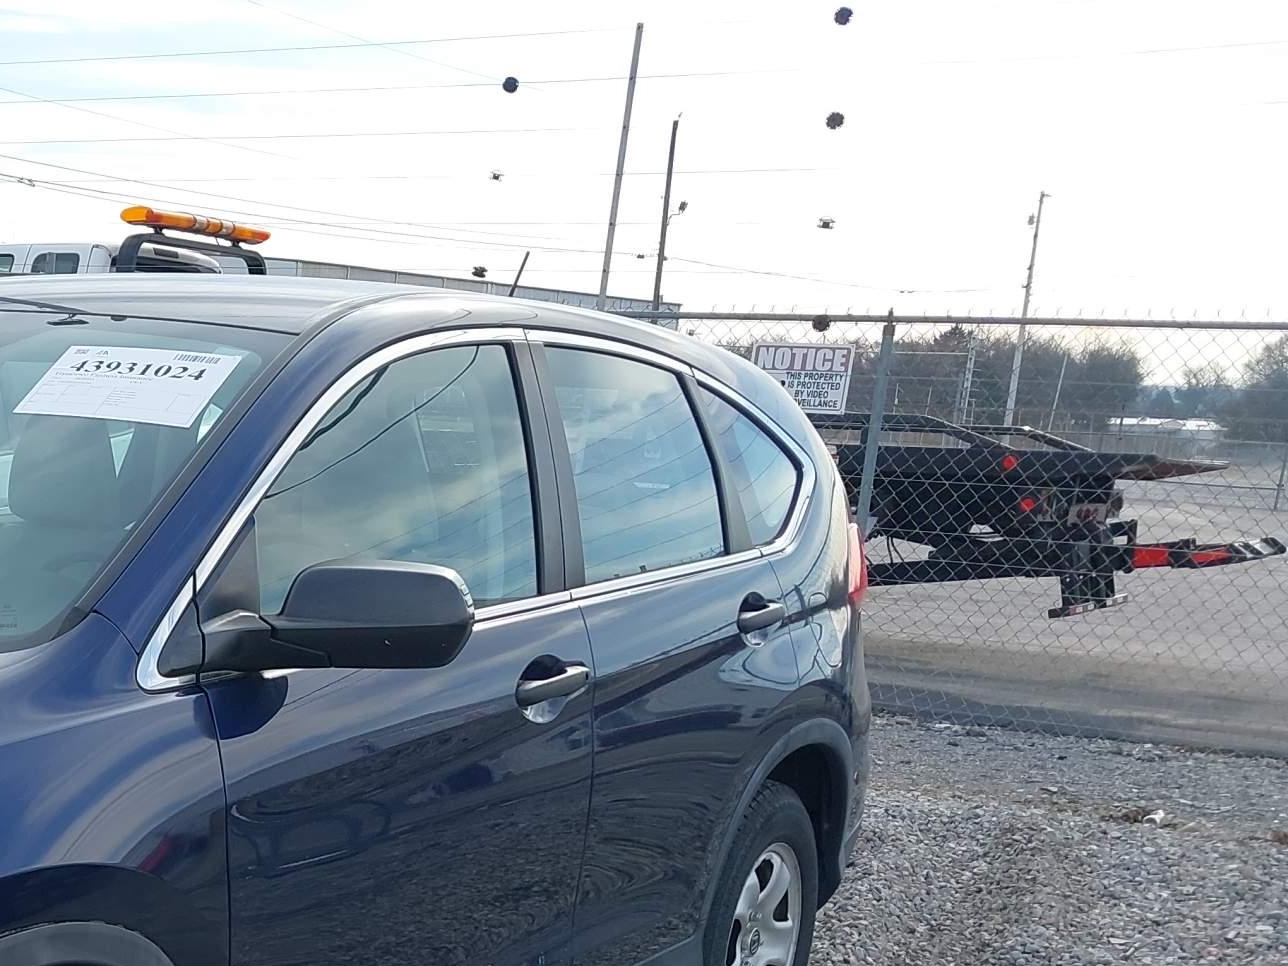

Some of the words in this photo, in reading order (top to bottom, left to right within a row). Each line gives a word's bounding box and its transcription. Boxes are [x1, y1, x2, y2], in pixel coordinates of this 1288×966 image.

[757, 346, 848, 372] NOTICE
[70, 360, 207, 381] 43931024
[785, 371, 802, 380] THIS
[803, 372, 844, 382] PROPERTY
[787, 380, 795, 389] IS
[796, 381, 841, 391] PROTECTED
[794, 390, 805, 398] BY
[806, 390, 829, 399] VIDEO
